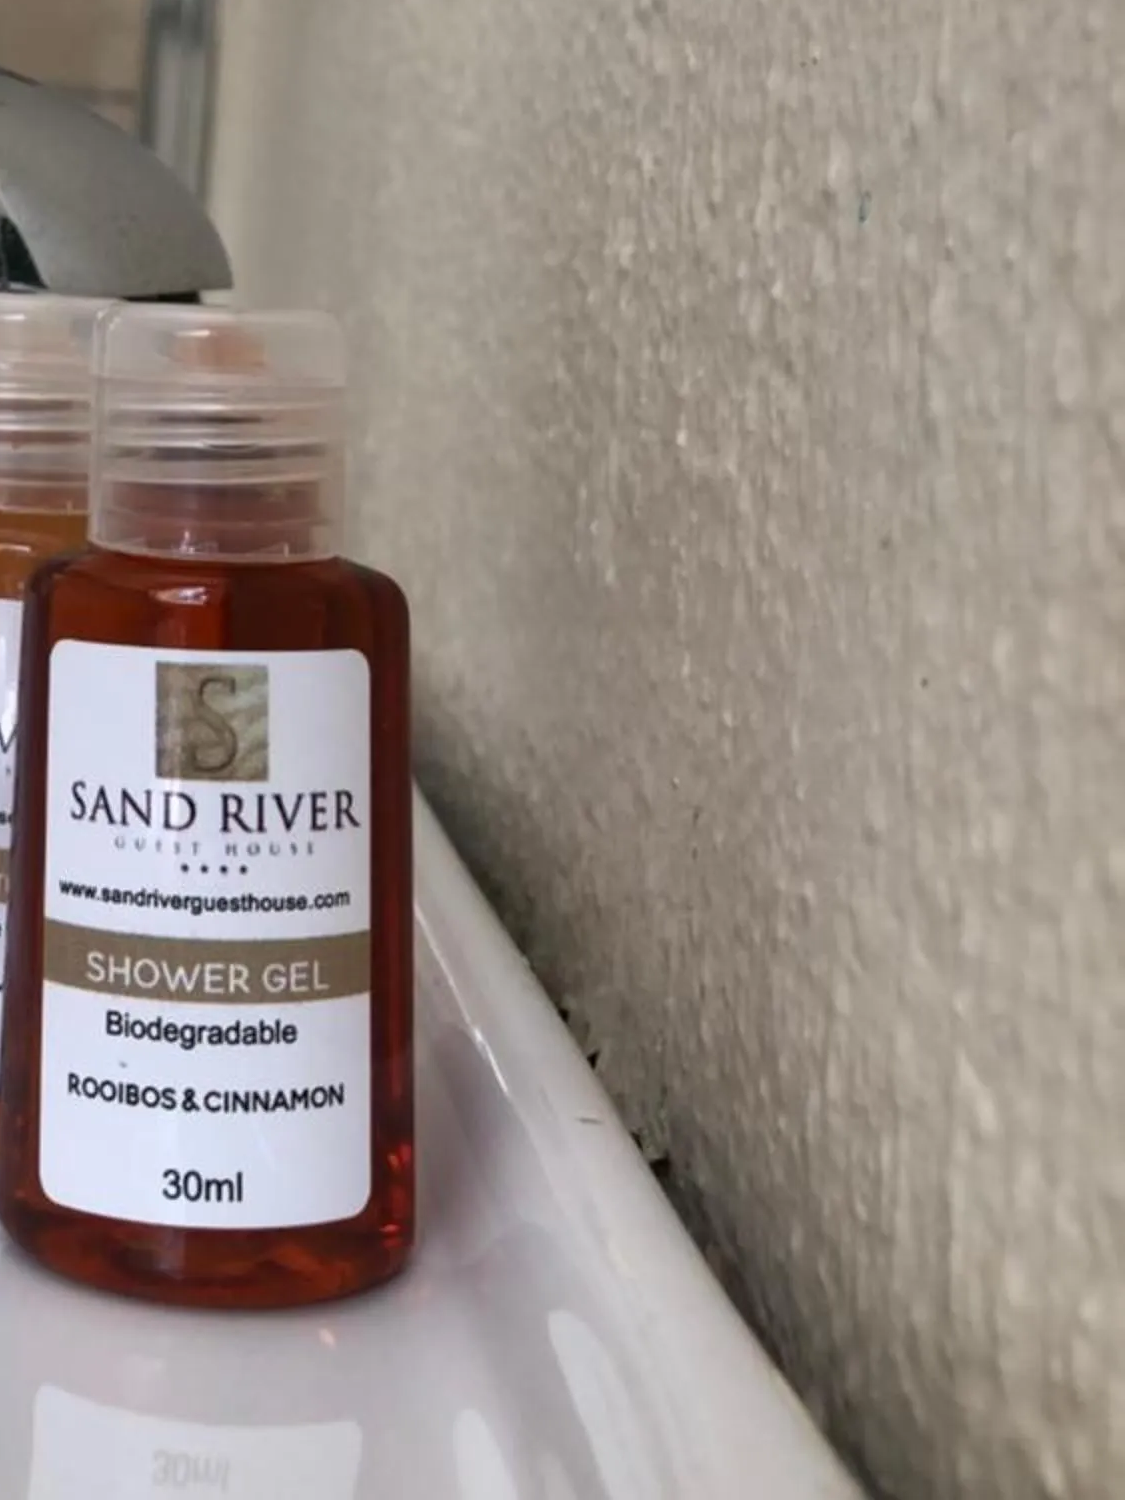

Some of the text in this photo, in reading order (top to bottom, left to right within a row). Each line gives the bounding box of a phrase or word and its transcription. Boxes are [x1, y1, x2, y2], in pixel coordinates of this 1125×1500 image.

[186, 677, 237, 774] S
[70, 780, 361, 834] SAND RIVER
[114, 835, 315, 857] GUEST HOUSE
[59, 879, 351, 915] www.sandriverguesthouse.com
[86, 951, 330, 994] SHOWER GEL
[106, 1010, 298, 1049] Biodegradable
[203, 1083, 345, 1113] CINNAMON
[162, 1168, 243, 1202] 30ml
